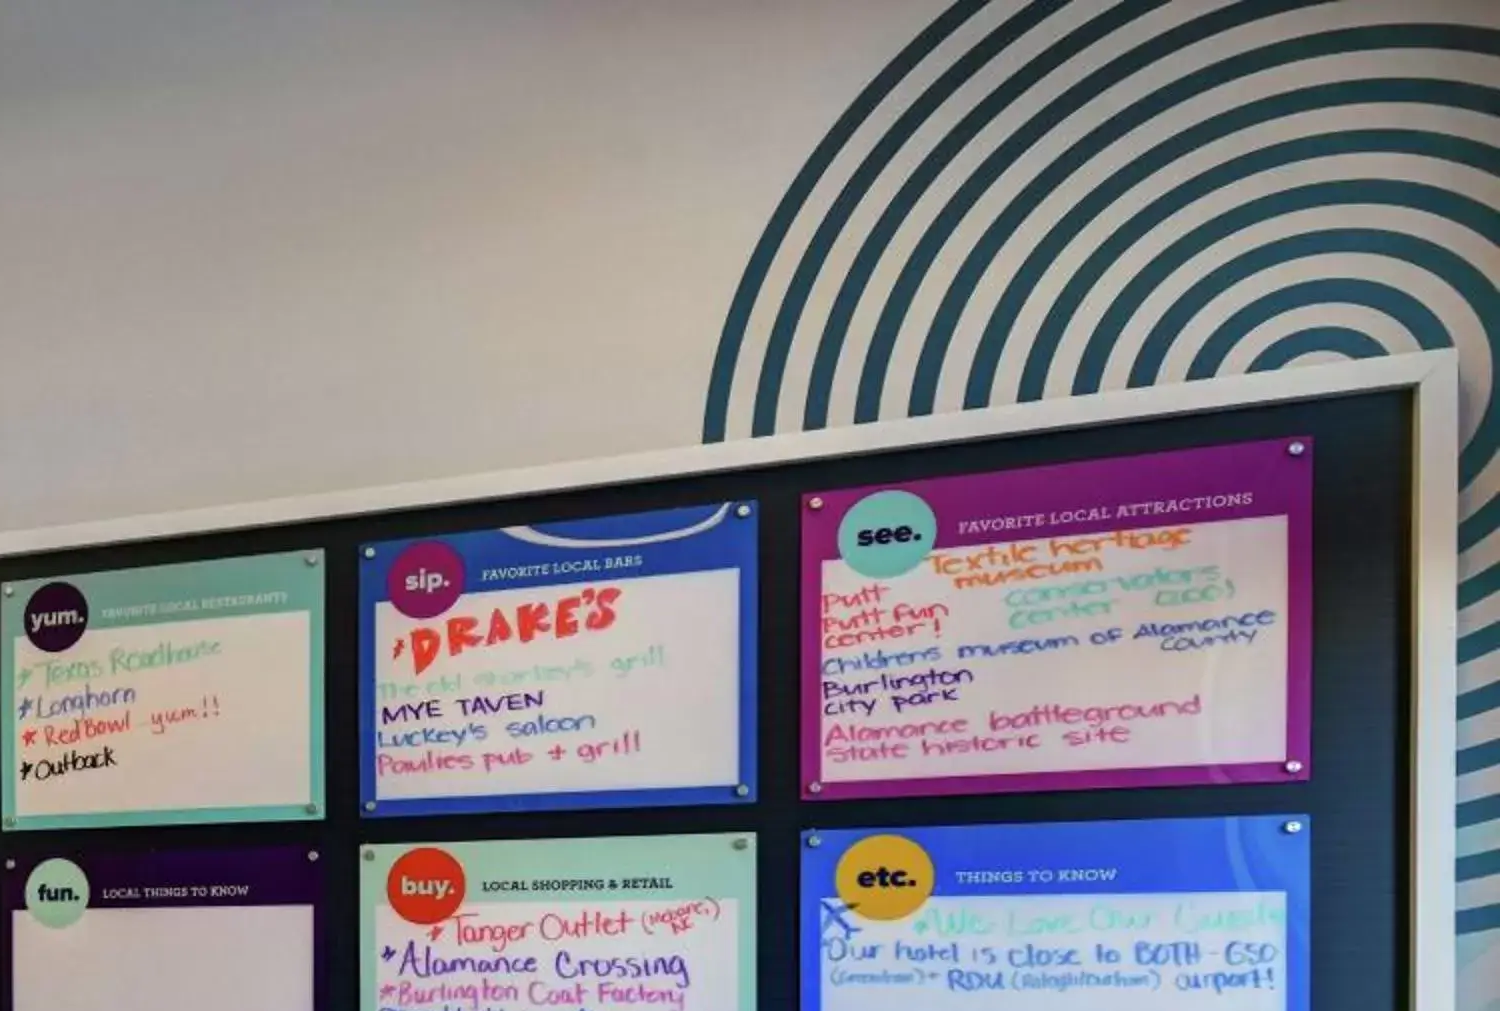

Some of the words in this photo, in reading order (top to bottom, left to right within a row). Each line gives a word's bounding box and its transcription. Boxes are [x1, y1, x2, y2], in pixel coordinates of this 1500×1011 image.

[958, 512, 1046, 534] FAVORITE
[1050, 506, 1112, 526] LOCAL
[1116, 492, 1254, 519] ATTRACTIONS
[856, 525, 922, 547] see.
[923, 542, 1039, 577] Textile
[1049, 526, 1192, 557] heritage
[404, 567, 450, 593] sip.
[481, 562, 550, 581] FAVORITE
[553, 559, 602, 574] LOCAL
[604, 555, 643, 570] BARS
[953, 556, 1105, 591] museum
[32, 611, 85, 632] yum.
[410, 587, 622, 676] DRAKE'S
[957, 634, 1079, 661] museum
[1132, 609, 1276, 639] Alamance
[34, 659, 103, 686] Texas
[110, 641, 222, 676] Roadhouse
[822, 668, 974, 701] Burlington
[891, 688, 960, 713] park
[35, 685, 136, 719] Longhorn
[381, 698, 444, 724] MYE
[455, 690, 544, 718] TAVEN
[505, 714, 596, 739] saloon
[824, 718, 969, 747] Alamance
[988, 694, 1203, 734] battleground
[483, 749, 533, 774] pub
[577, 730, 642, 763] grill
[921, 734, 1042, 756] historic
[1062, 724, 1132, 749] site
[35, 746, 118, 781] Outback
[37, 883, 80, 902] fun.
[102, 887, 141, 899] LOCAL
[144, 887, 189, 898] THINGS
[190, 886, 209, 897] TO
[211, 885, 250, 897] KNOW
[402, 876, 455, 899] buy.
[481, 879, 529, 892] LOCAL
[531, 878, 606, 892] SHOPPING
[608, 878, 619, 890] &
[621, 877, 674, 890] RETAIL
[857, 865, 918, 888] etc.
[955, 869, 1024, 885] THINGS
[1028, 869, 1054, 883] TO
[1058, 868, 1119, 883] KNOW
[452, 913, 534, 951] Tanger
[540, 911, 634, 941] Outlet
[398, 940, 538, 978] Alamance
[555, 950, 691, 988] Crossing
[826, 937, 884, 962] Our
[894, 940, 961, 963] hotel
[971, 947, 997, 965] is
[1007, 944, 1082, 967] close
[1095, 943, 1122, 965] to
[1134, 940, 1202, 966] BOTH
[1224, 940, 1279, 966] GSO
[397, 979, 519, 1011] Burlington
[528, 981, 590, 1005] Coat
[947, 969, 1006, 992] RDU
